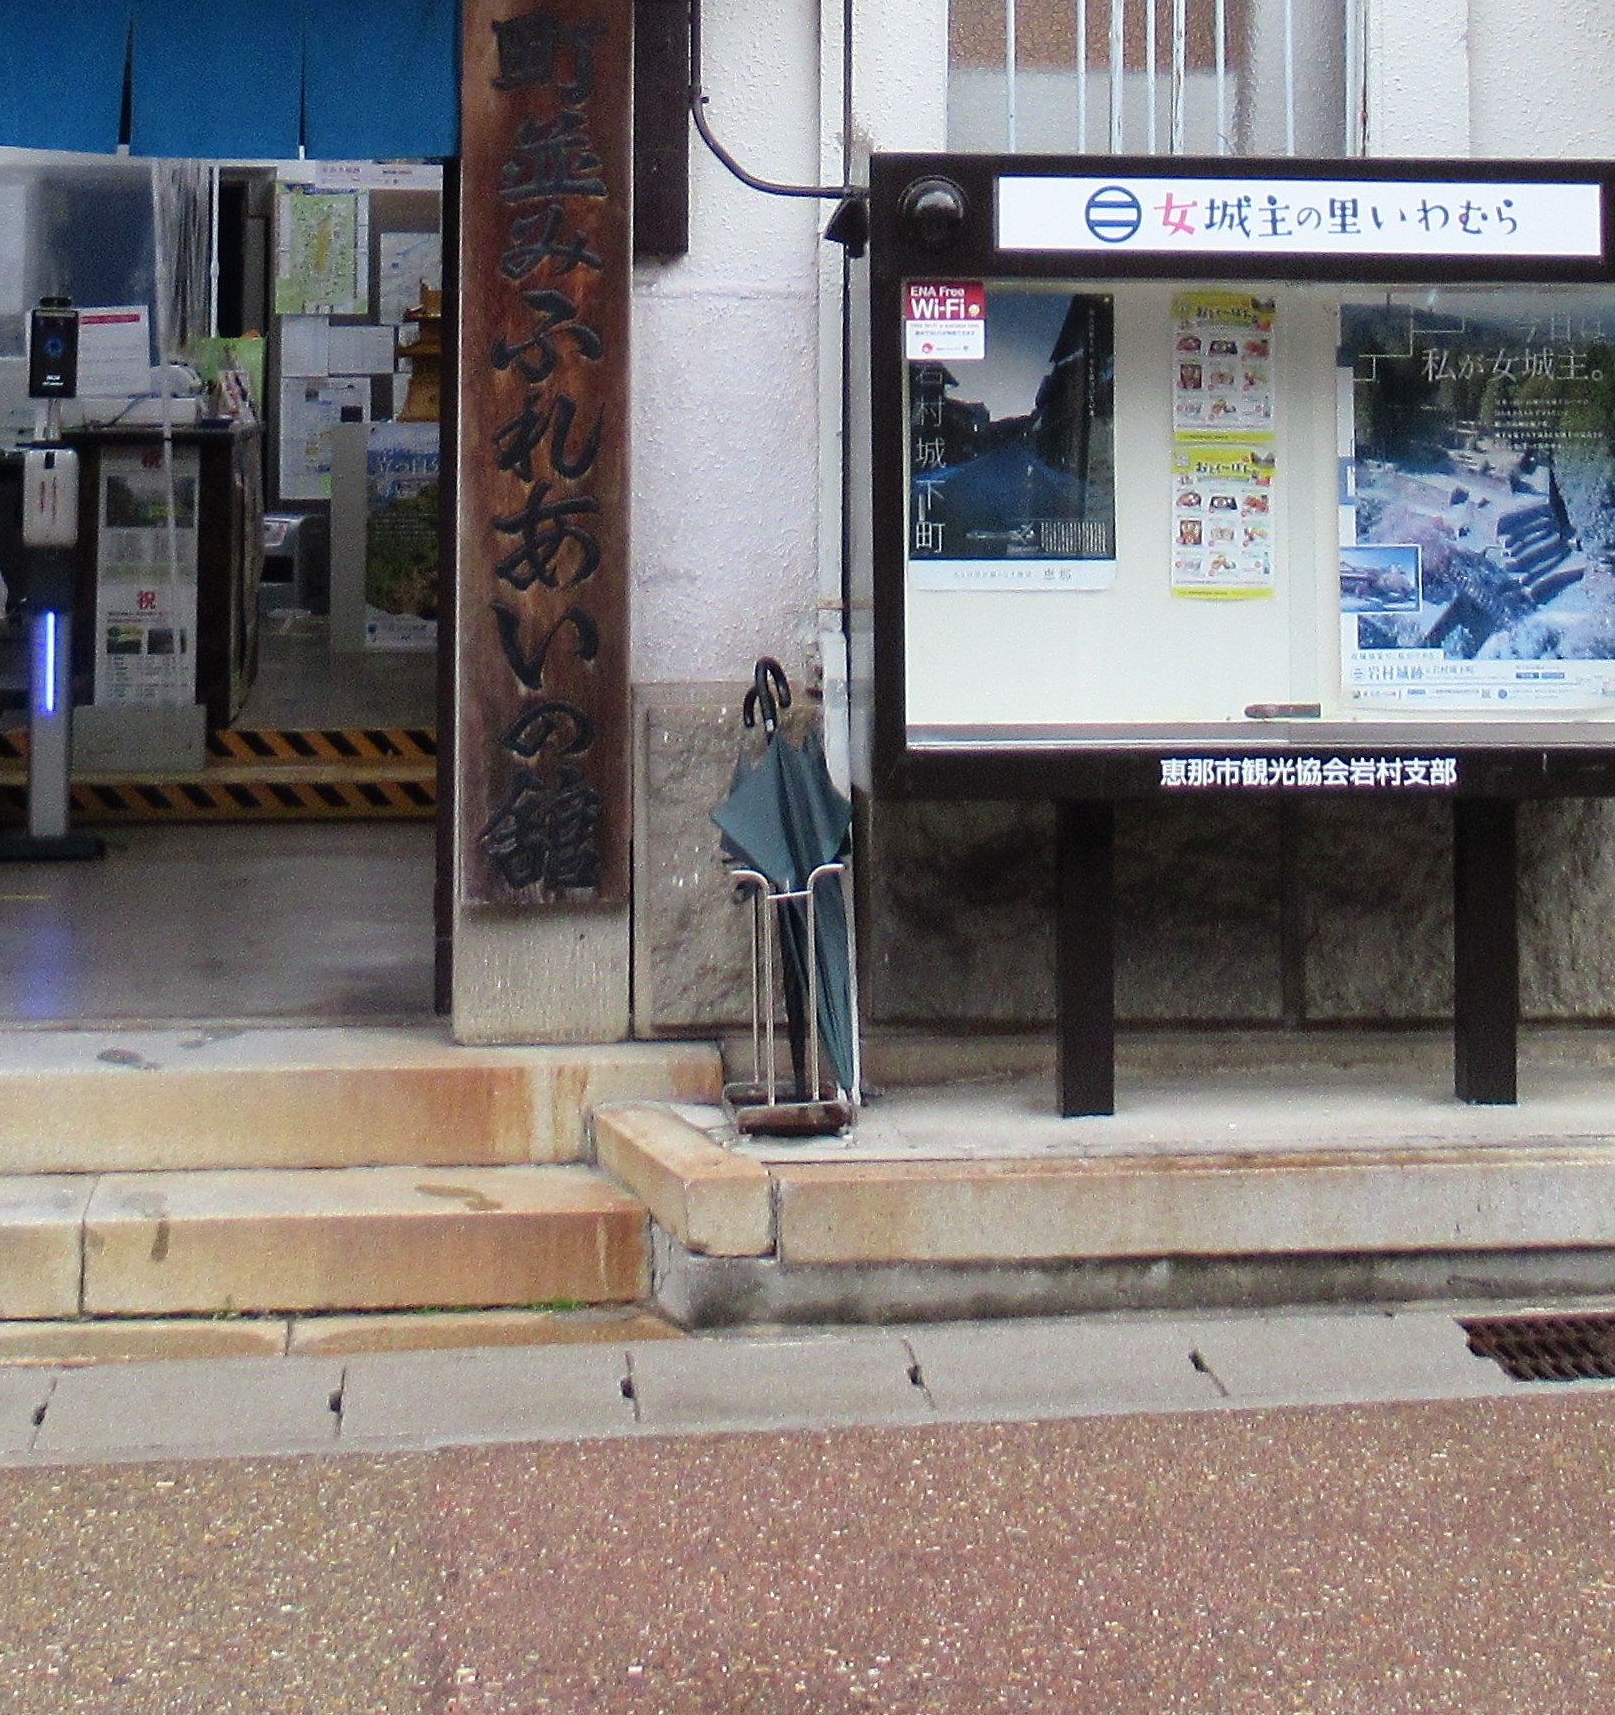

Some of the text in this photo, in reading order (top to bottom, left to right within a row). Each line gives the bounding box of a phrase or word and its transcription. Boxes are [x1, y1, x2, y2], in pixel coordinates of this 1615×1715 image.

[1152, 190, 1519, 239] 女城主の里いわむら
[909, 286, 966, 297] ENA Free
[911, 298, 966, 319] Wi-Fi
[1421, 346, 1605, 383] 私が女城主。
[1159, 756, 1458, 788] 恵那市観光協会岩村支部
